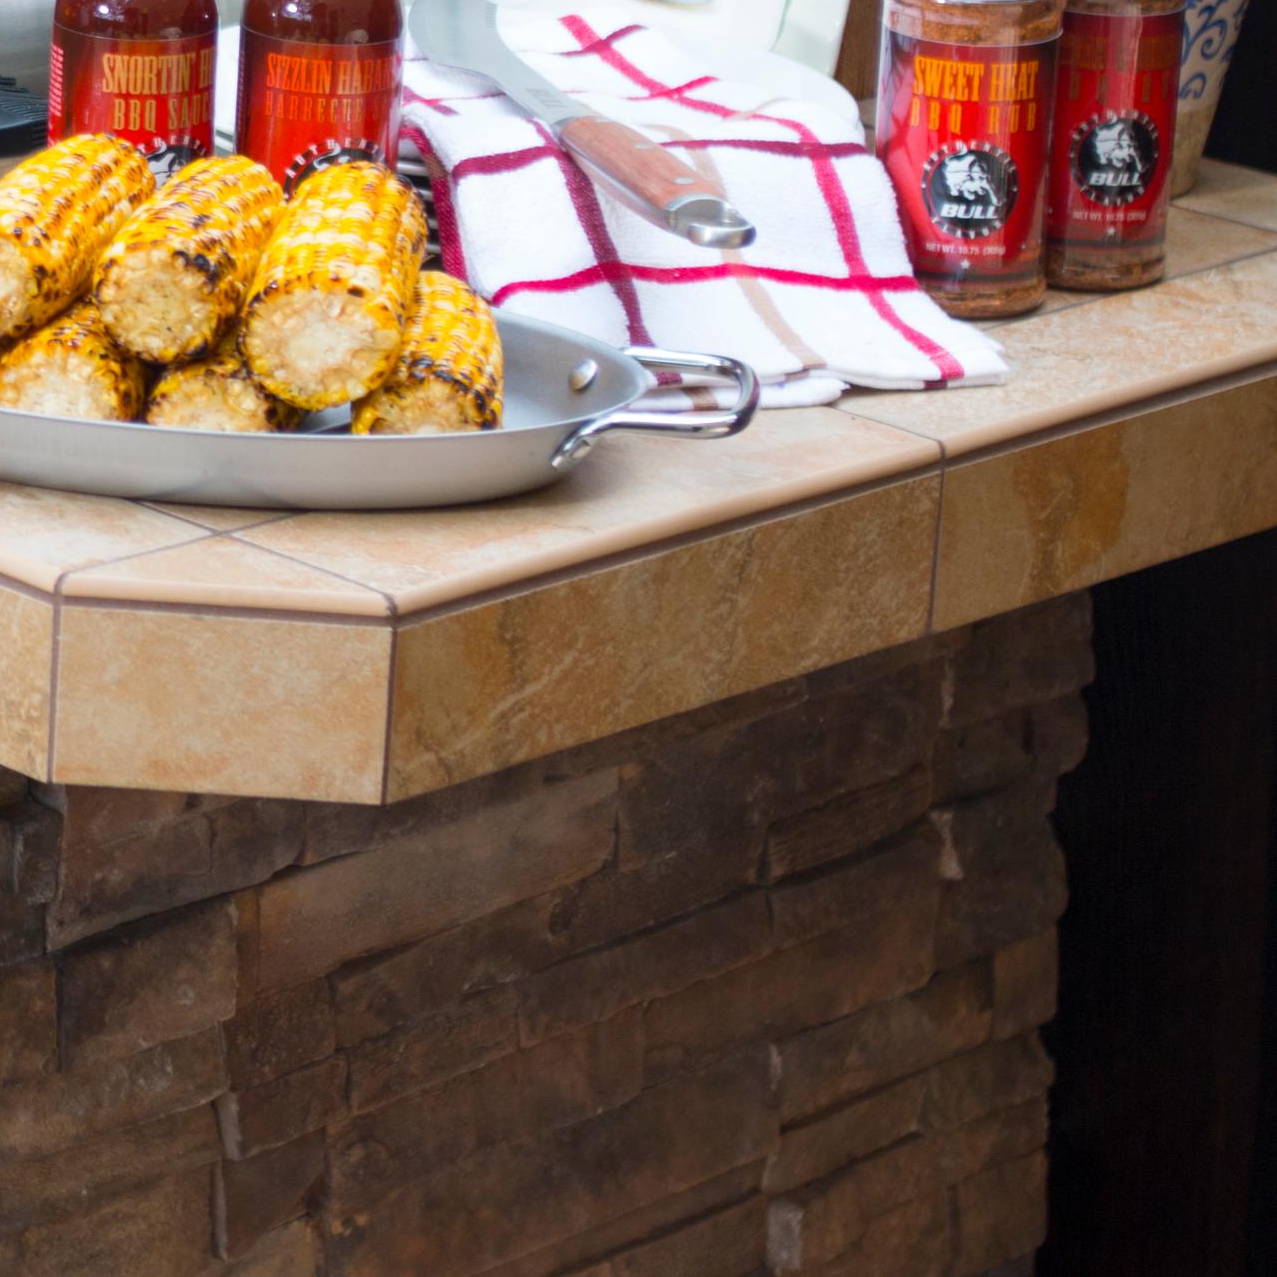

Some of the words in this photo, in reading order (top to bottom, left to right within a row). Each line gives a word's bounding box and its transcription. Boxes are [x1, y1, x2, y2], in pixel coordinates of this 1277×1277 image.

[265, 52, 333, 94] SIZZLIN
[913, 55, 984, 102] SWEET
[989, 59, 1039, 102] HEAT
[112, 98, 157, 133] BBQ
[265, 90, 365, 123] BARBECUE
[910, 96, 962, 135] BBQ
[988, 102, 1036, 134] RUB
[285, 137, 379, 179] AUTHENT
[1089, 171, 1143, 186] BULL
[940, 203, 999, 219] BULL
